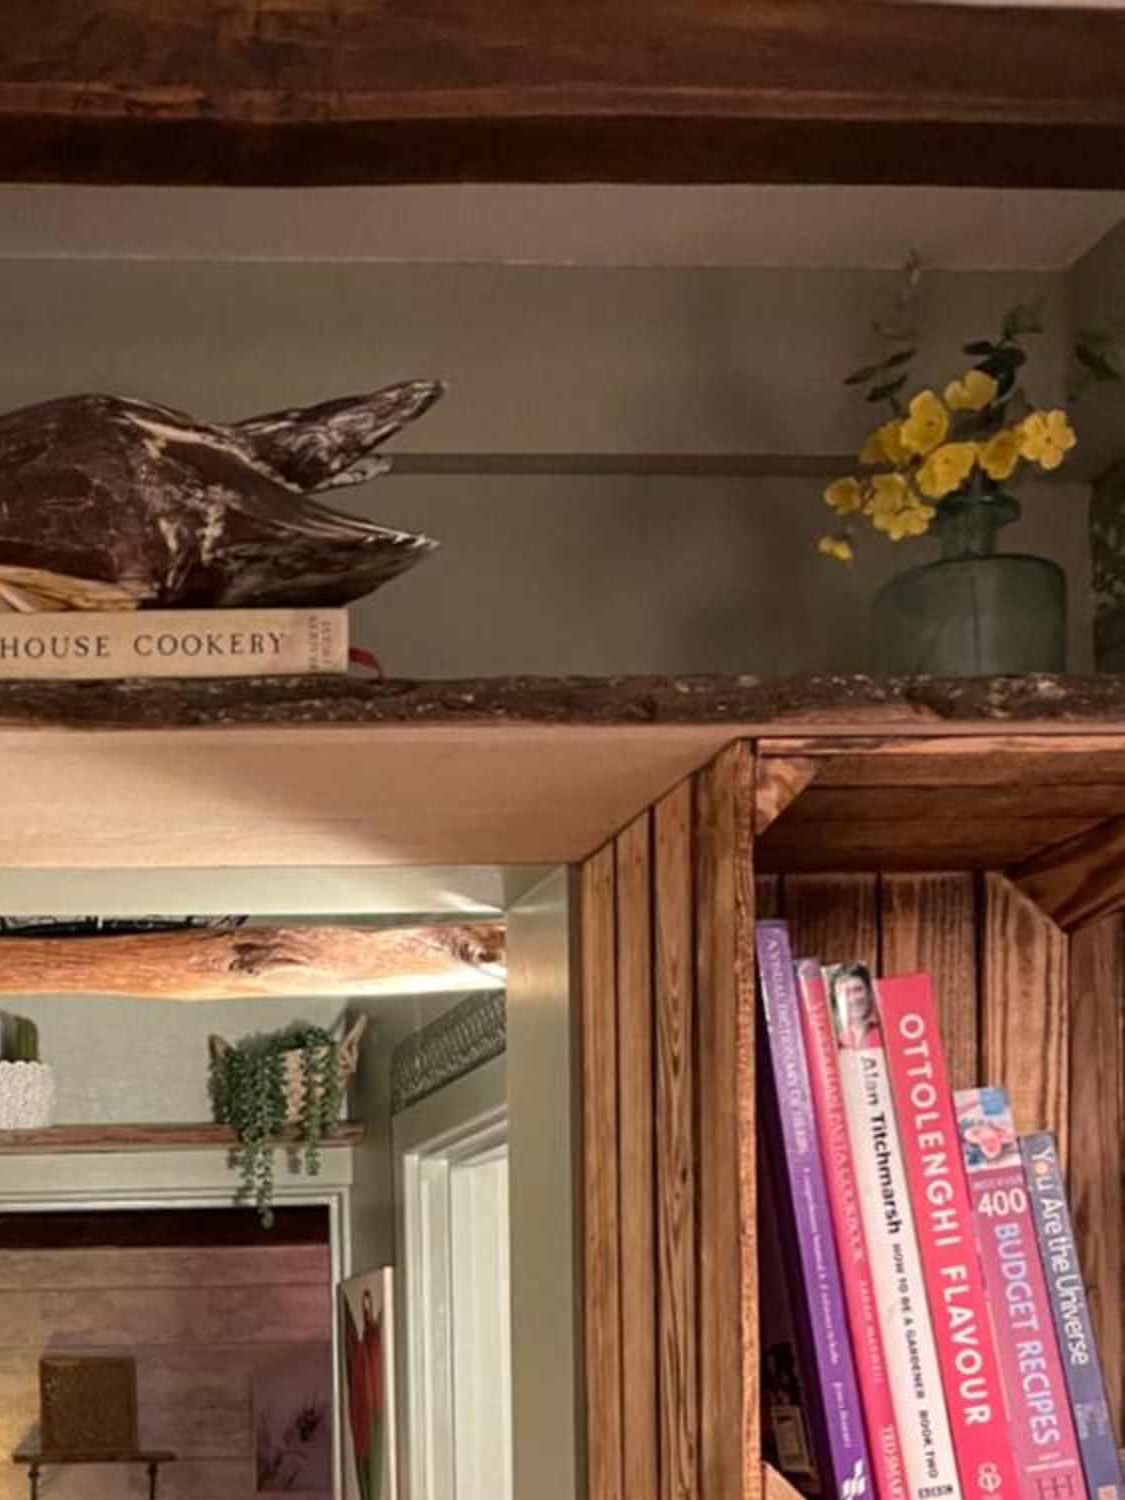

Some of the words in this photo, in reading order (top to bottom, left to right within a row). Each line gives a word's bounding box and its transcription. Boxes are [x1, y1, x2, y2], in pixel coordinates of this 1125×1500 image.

[133, 632, 285, 658] COOKERY
[861, 1056, 881, 1106] Alan
[869, 1111, 903, 1235] Titchmarsh
[1032, 1145, 1054, 1191] You
[899, 1012, 962, 1247] OTTOLENGHI
[941, 1265, 991, 1428] FLAVOUR
[977, 1190, 1025, 1216] 400
[1041, 1196, 1065, 1234] Are
[890, 1242, 906, 1273] HOW
[1049, 1236, 1069, 1272] the
[896, 1277, 909, 1294] TO
[899, 1295, 912, 1313] BE
[902, 1315, 914, 1326] A
[995, 1222, 1039, 1331] BUDGET
[1017, 1340, 1059, 1444] RECIPES
[1055, 1276, 1089, 1366] Universe
[904, 1328, 926, 1400] GARDENER
[917, 1408, 934, 1447] BOOK
[924, 1450, 939, 1480] TWO
